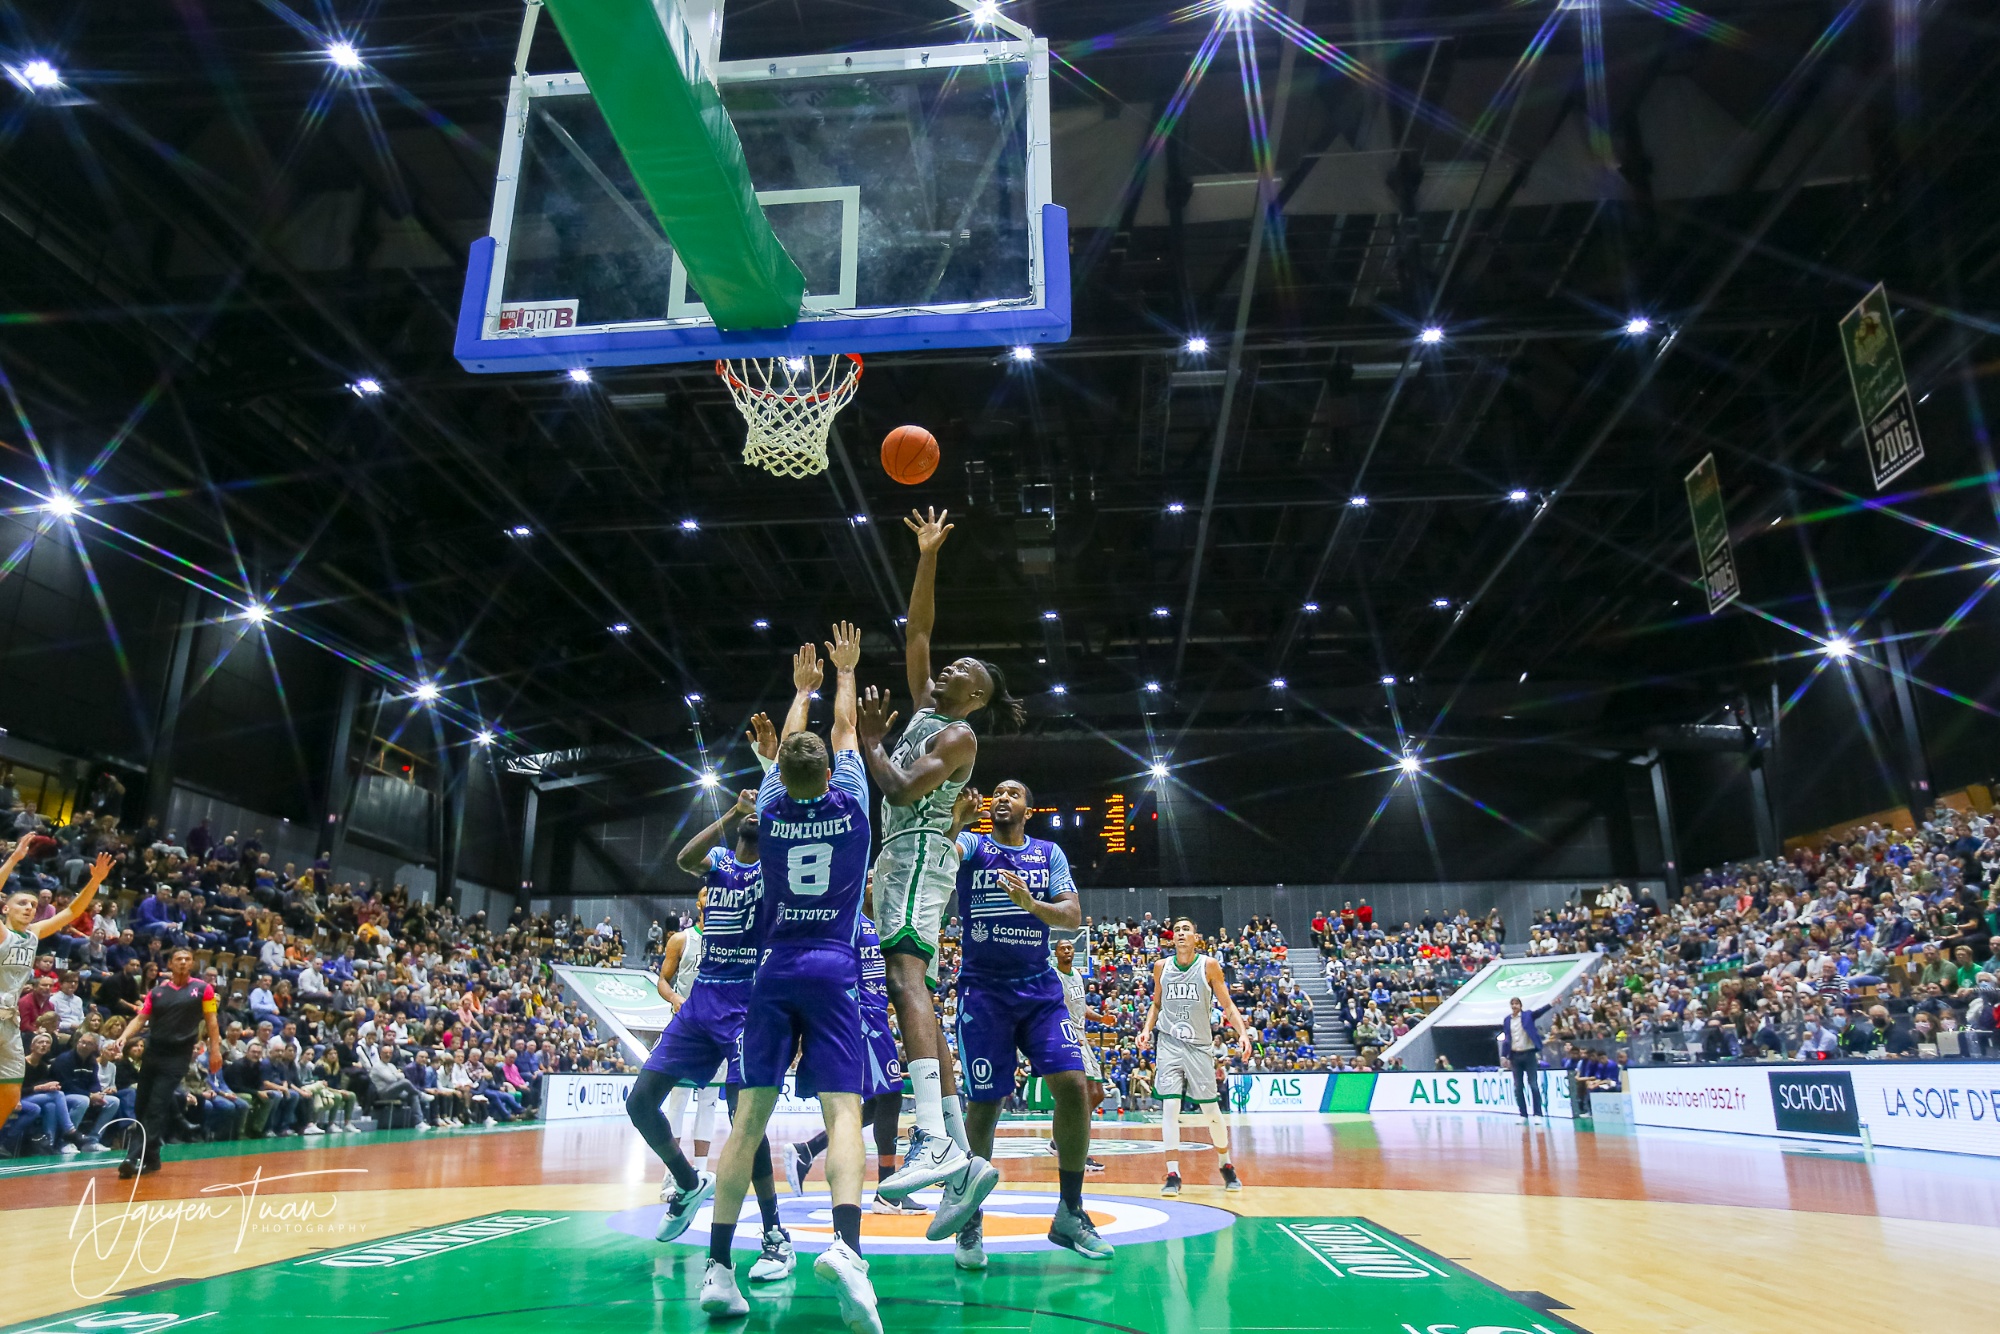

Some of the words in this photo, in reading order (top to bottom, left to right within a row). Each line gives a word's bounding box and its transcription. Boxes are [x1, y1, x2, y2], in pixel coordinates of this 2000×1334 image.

[501, 311, 517, 319] LNB
[1874, 419, 1914, 470] 2016
[770, 814, 852, 839] DUWIQUET
[939, 843, 951, 868] 7
[787, 842, 834, 896] 8
[745, 904, 756, 931] 6
[784, 908, 841, 922] CITOYEN
[992, 924, 1043, 940] écomiam
[2, 946, 34, 967] ADA
[709, 943, 758, 957] écomiam
[1166, 982, 1200, 1001] ADA
[1175, 1004, 1190, 1021] 45
[1269, 1078, 1301, 1097] ALS
[1409, 1078, 1461, 1105] ALS
[1638, 1086, 1747, 1111] www.schoen1952.fr
[1778, 1083, 1847, 1112] SCHOEN
[1882, 1087, 1911, 1117] LA
[1913, 1088, 1960, 1120] SOIF
[1289, 1223, 1431, 1279] SIDAMO
